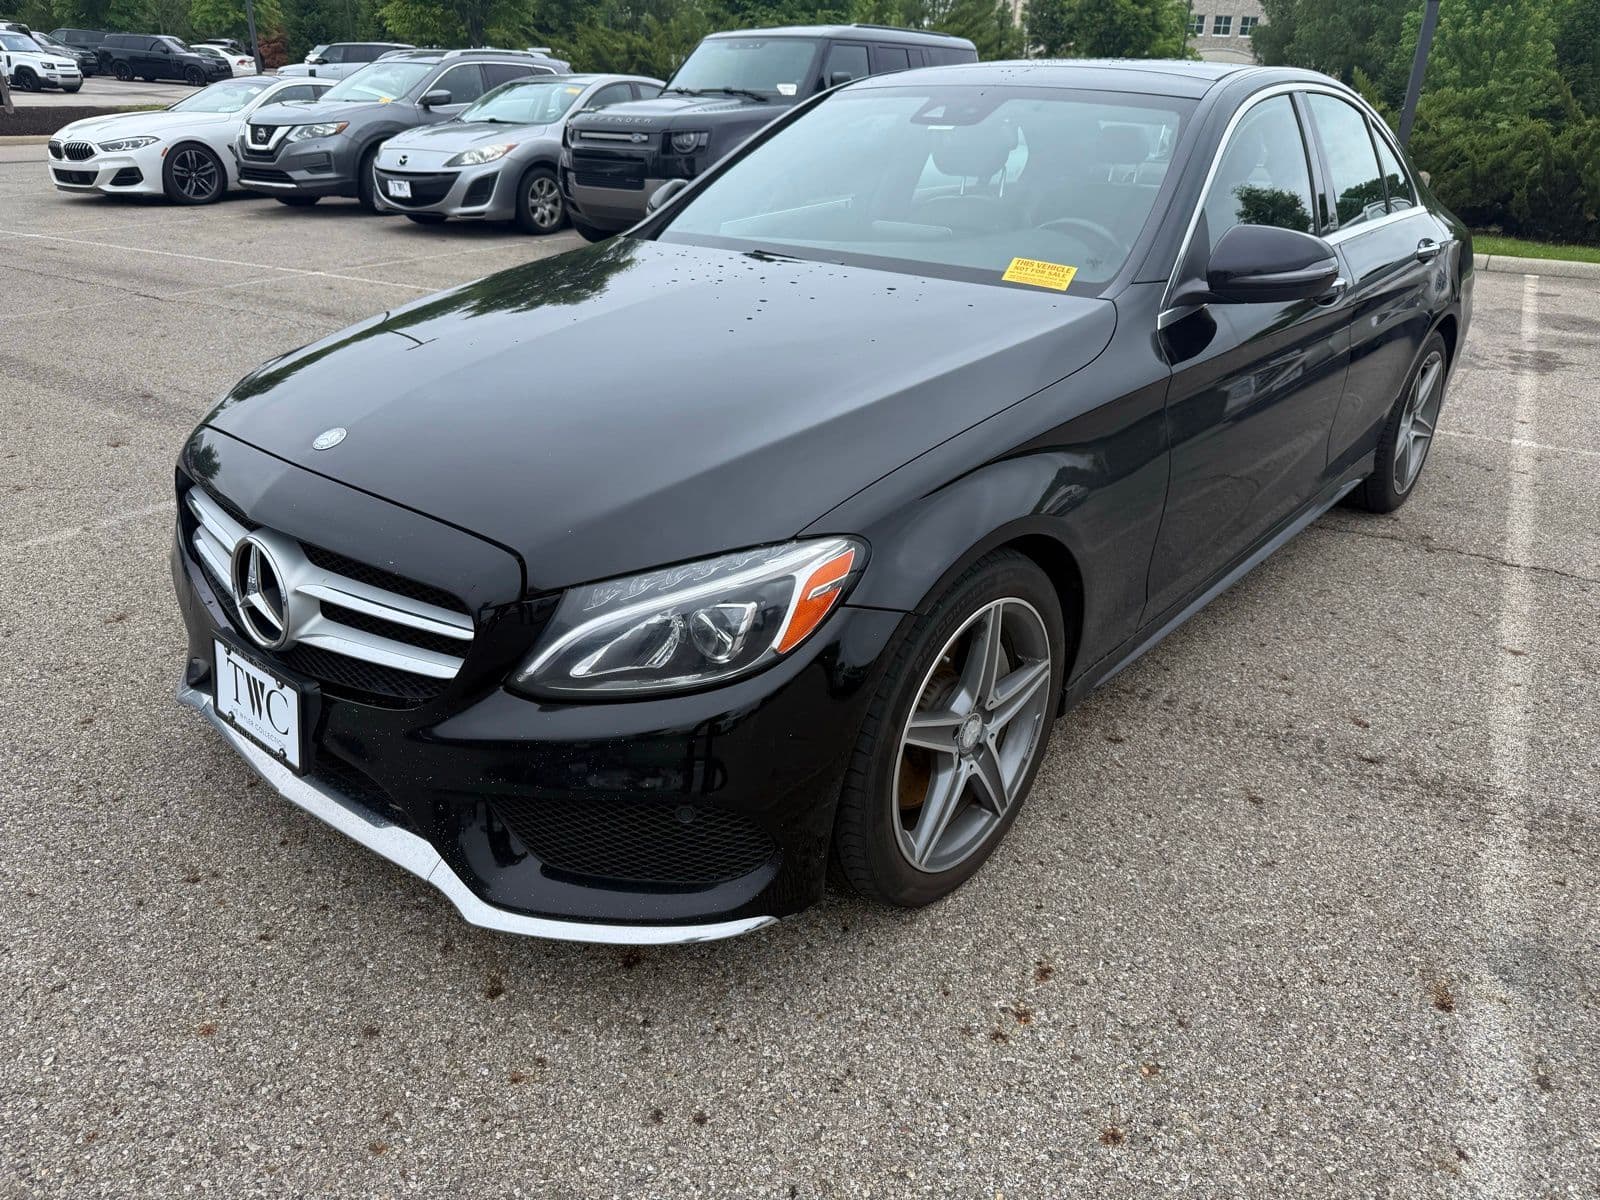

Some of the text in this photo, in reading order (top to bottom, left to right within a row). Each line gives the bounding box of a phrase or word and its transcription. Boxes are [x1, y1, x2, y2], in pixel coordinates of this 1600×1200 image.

[1016, 259, 1073, 274] THIS VEHICLE
[1048, 270, 1067, 278] SALE
[226, 657, 289, 735] TWC
